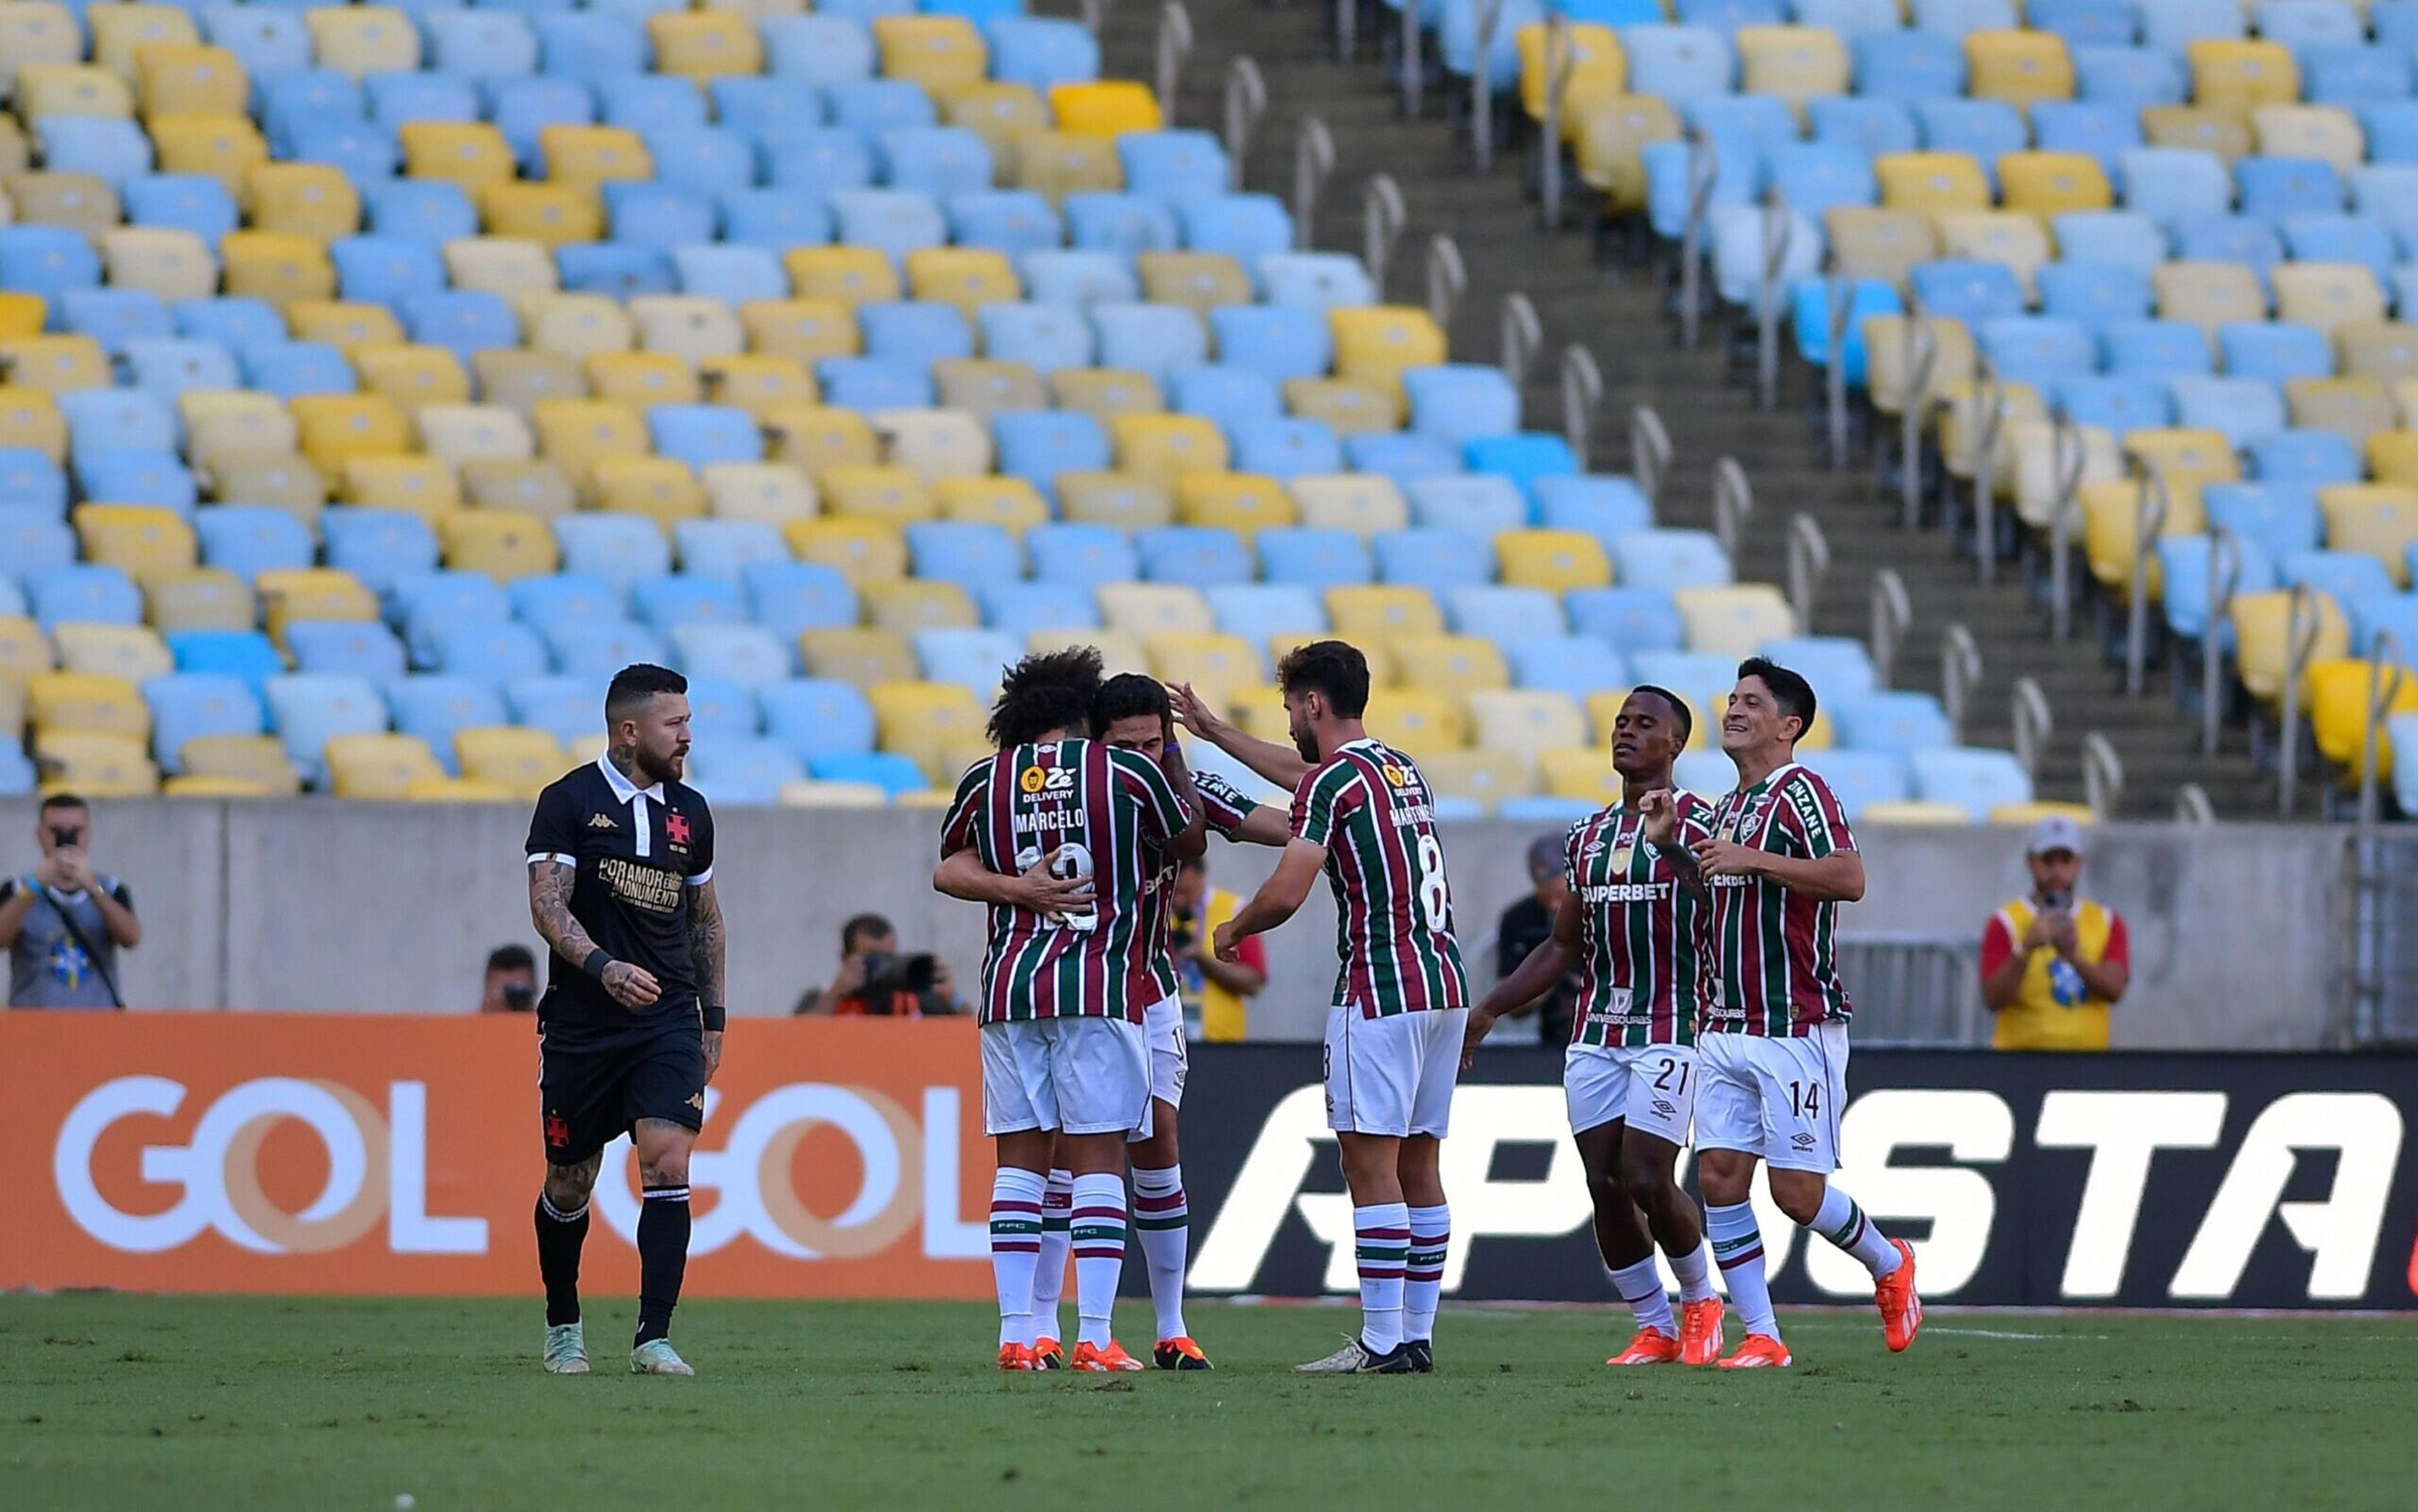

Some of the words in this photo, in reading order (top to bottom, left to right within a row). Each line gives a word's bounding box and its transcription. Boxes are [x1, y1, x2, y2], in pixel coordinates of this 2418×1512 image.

[1045, 767, 1076, 788] Zé
[1189, 771, 1237, 803] ZANE
[1023, 790, 1074, 803] DELIVERY
[1786, 780, 1822, 839] ZINZANE
[1016, 809, 1084, 833] MARCELO
[613, 877, 679, 907] MONUMENTO
[1418, 834, 1446, 933] 8
[1581, 883, 1670, 903] SUPERBET
[1654, 1058, 1689, 1096] 21
[1789, 1080, 1819, 1119] 14
[54, 1074, 489, 1253] GOL
[1791, 1144, 1813, 1152] umbro
[594, 1081, 992, 1259] GOL
